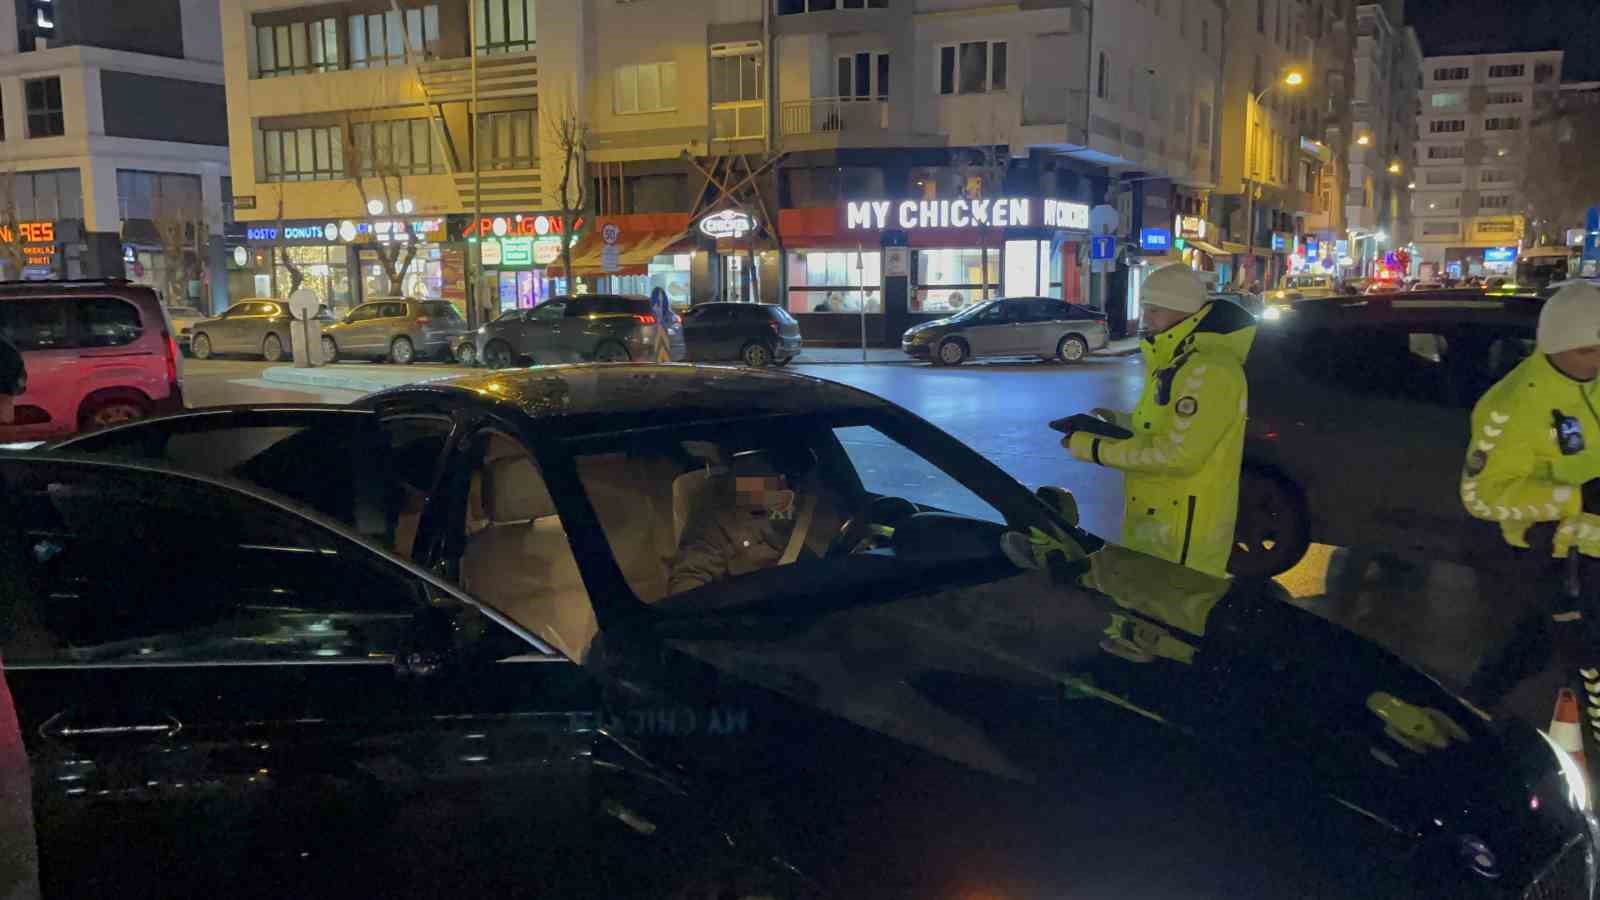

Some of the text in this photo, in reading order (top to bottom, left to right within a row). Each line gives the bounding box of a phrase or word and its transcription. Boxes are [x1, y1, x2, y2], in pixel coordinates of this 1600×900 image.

[847, 199, 1029, 229] MY CHICKEN
[248, 227, 322, 240] BOSTO DONUTS
